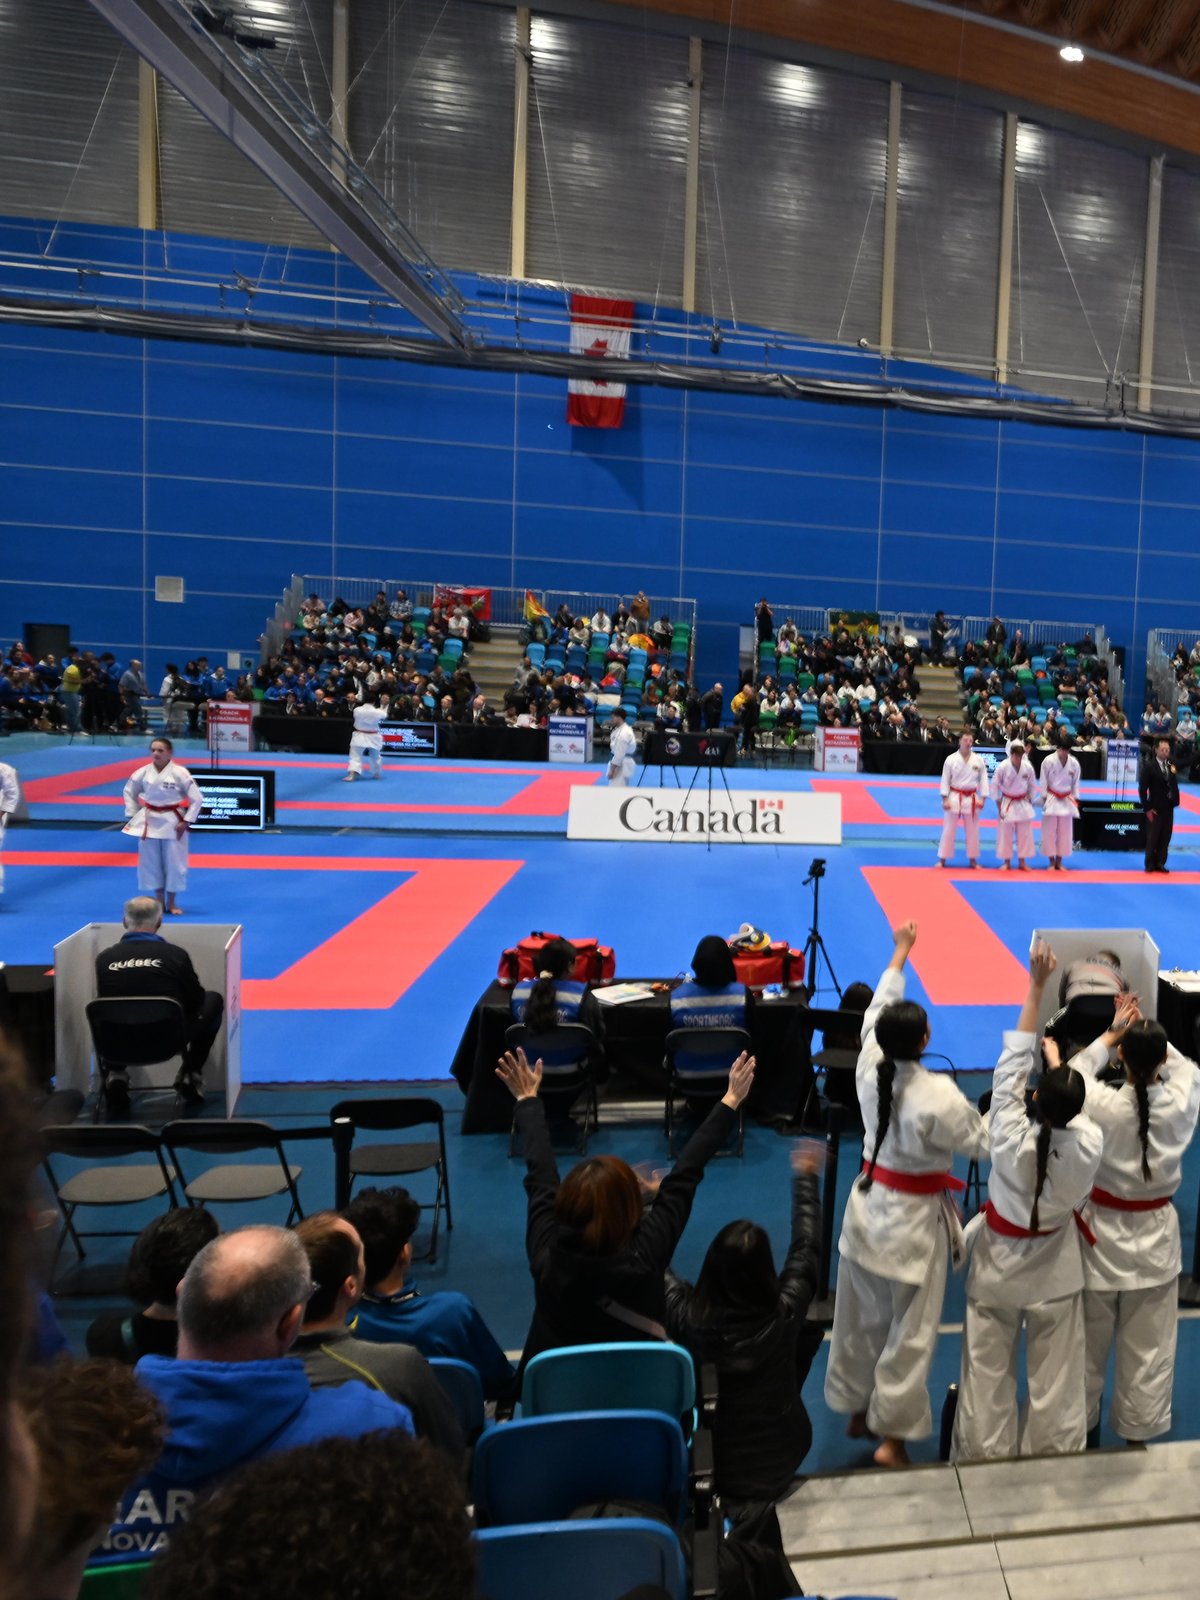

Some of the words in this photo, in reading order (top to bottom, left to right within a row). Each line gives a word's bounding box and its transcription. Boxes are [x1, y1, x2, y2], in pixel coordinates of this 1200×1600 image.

[1110, 802, 1136, 810] WINNER
[619, 795, 785, 835] Canada
[108, 958, 162, 972] QUÉBEC
